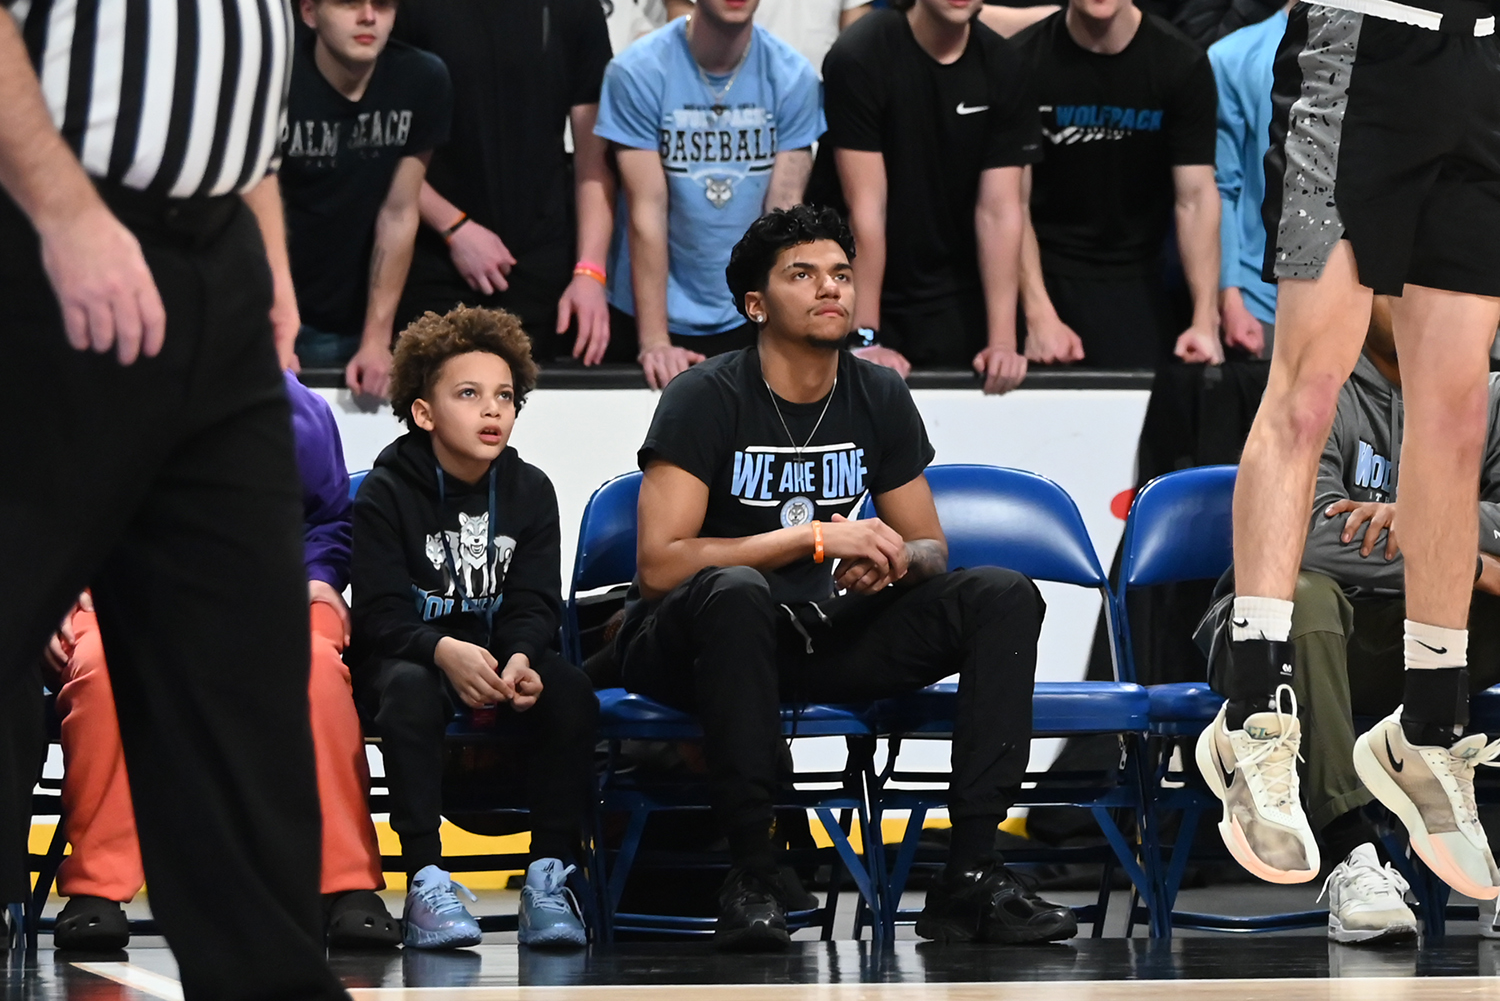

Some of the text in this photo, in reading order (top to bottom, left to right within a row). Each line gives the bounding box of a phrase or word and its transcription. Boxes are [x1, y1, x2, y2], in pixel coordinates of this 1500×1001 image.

[730, 448, 868, 500] WE ARE ONE
